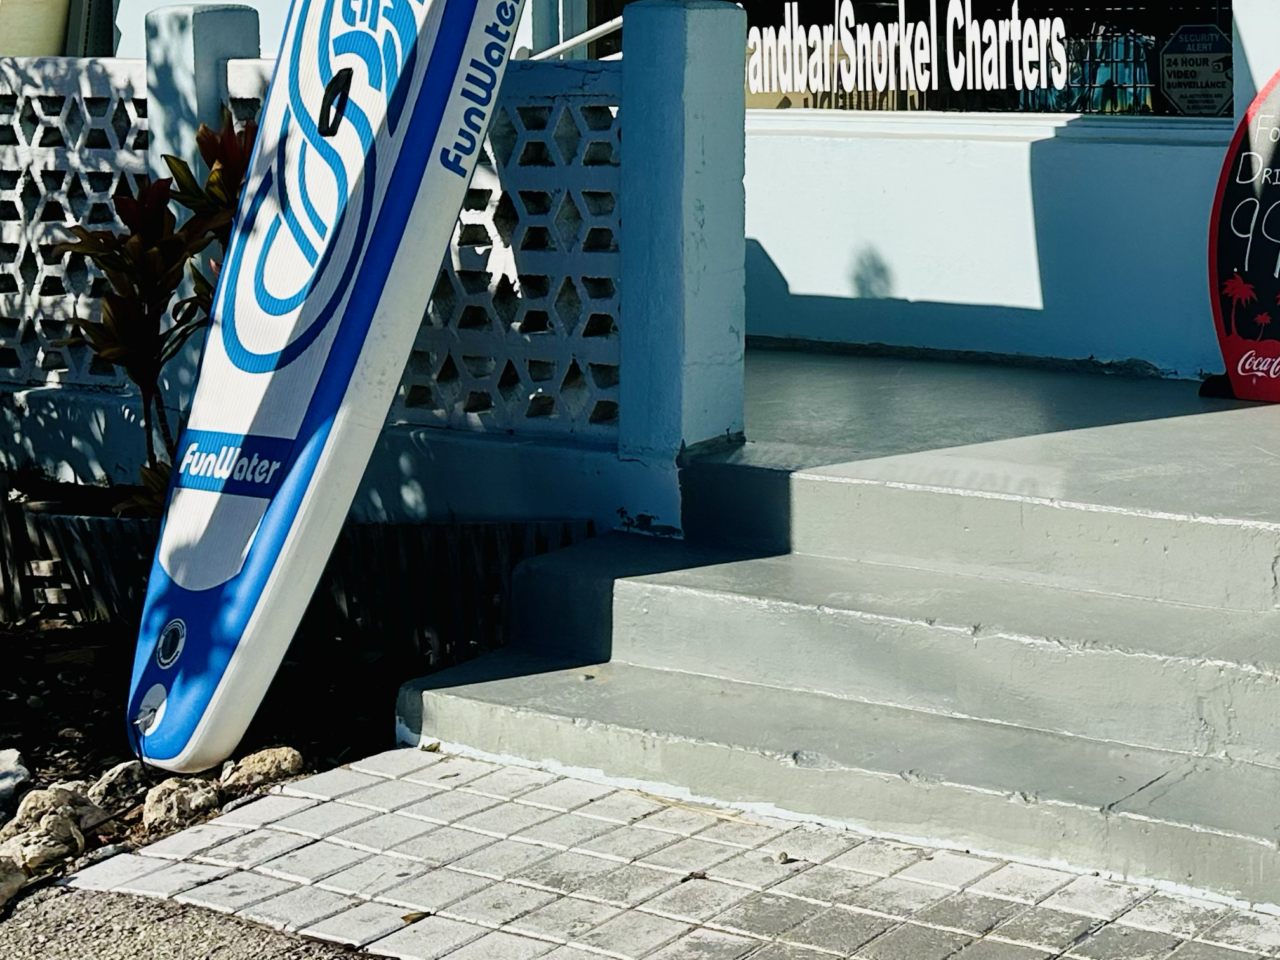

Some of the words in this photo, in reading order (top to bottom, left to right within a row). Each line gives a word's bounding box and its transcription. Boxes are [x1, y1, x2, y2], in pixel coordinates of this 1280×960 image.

[1178, 33, 1220, 43] SECURITY
[1186, 43, 1213, 52] ALERT
[1166, 58, 1178, 67] 24
[1181, 57, 1209, 67] HOUR
[1166, 70, 1197, 79] VIDEO
[1166, 81, 1226, 90] SURVEILLANCE
[179, 442, 281, 484] FunWater
